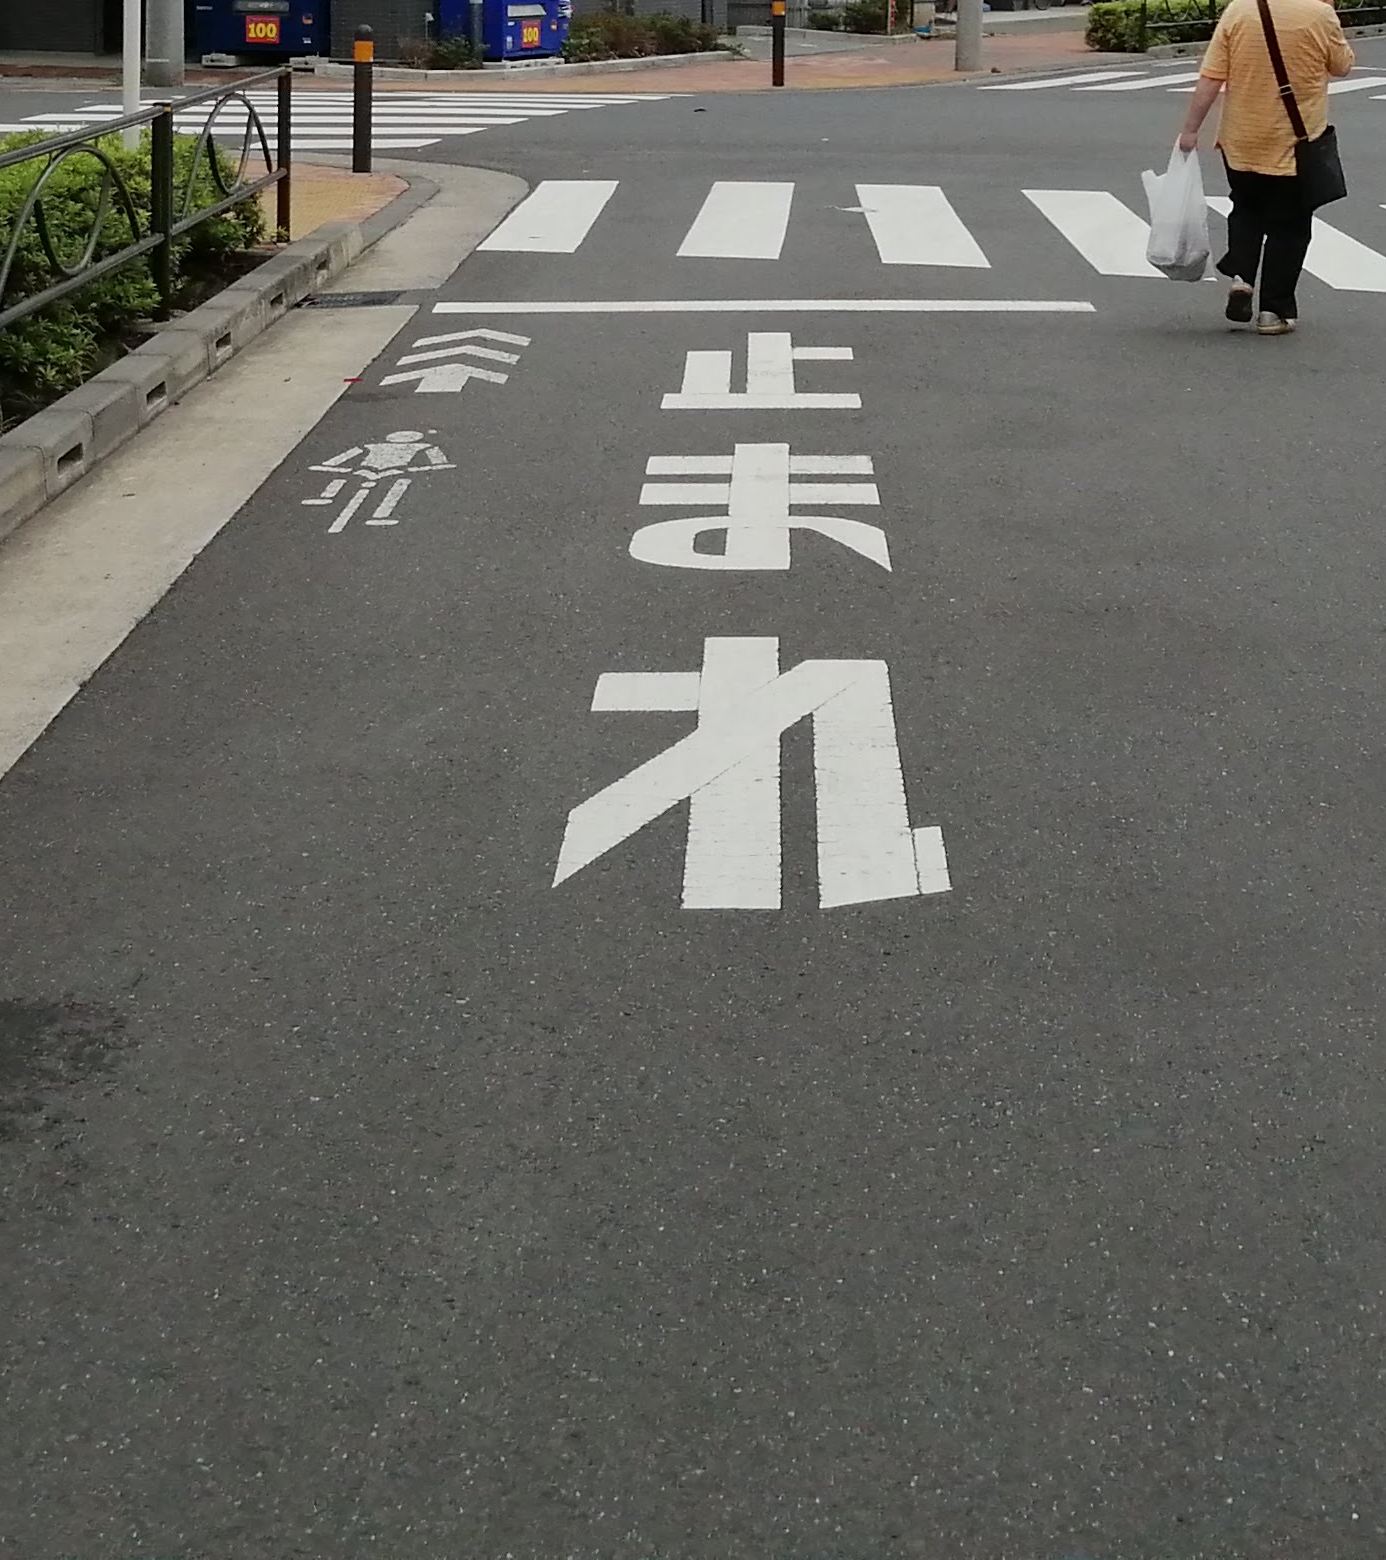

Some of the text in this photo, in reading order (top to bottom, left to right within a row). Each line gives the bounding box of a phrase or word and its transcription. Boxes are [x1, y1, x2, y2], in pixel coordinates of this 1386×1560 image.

[248, 23, 278, 38] 100
[522, 27, 539, 42] 100
[552, 332, 953, 910] 止まれ
